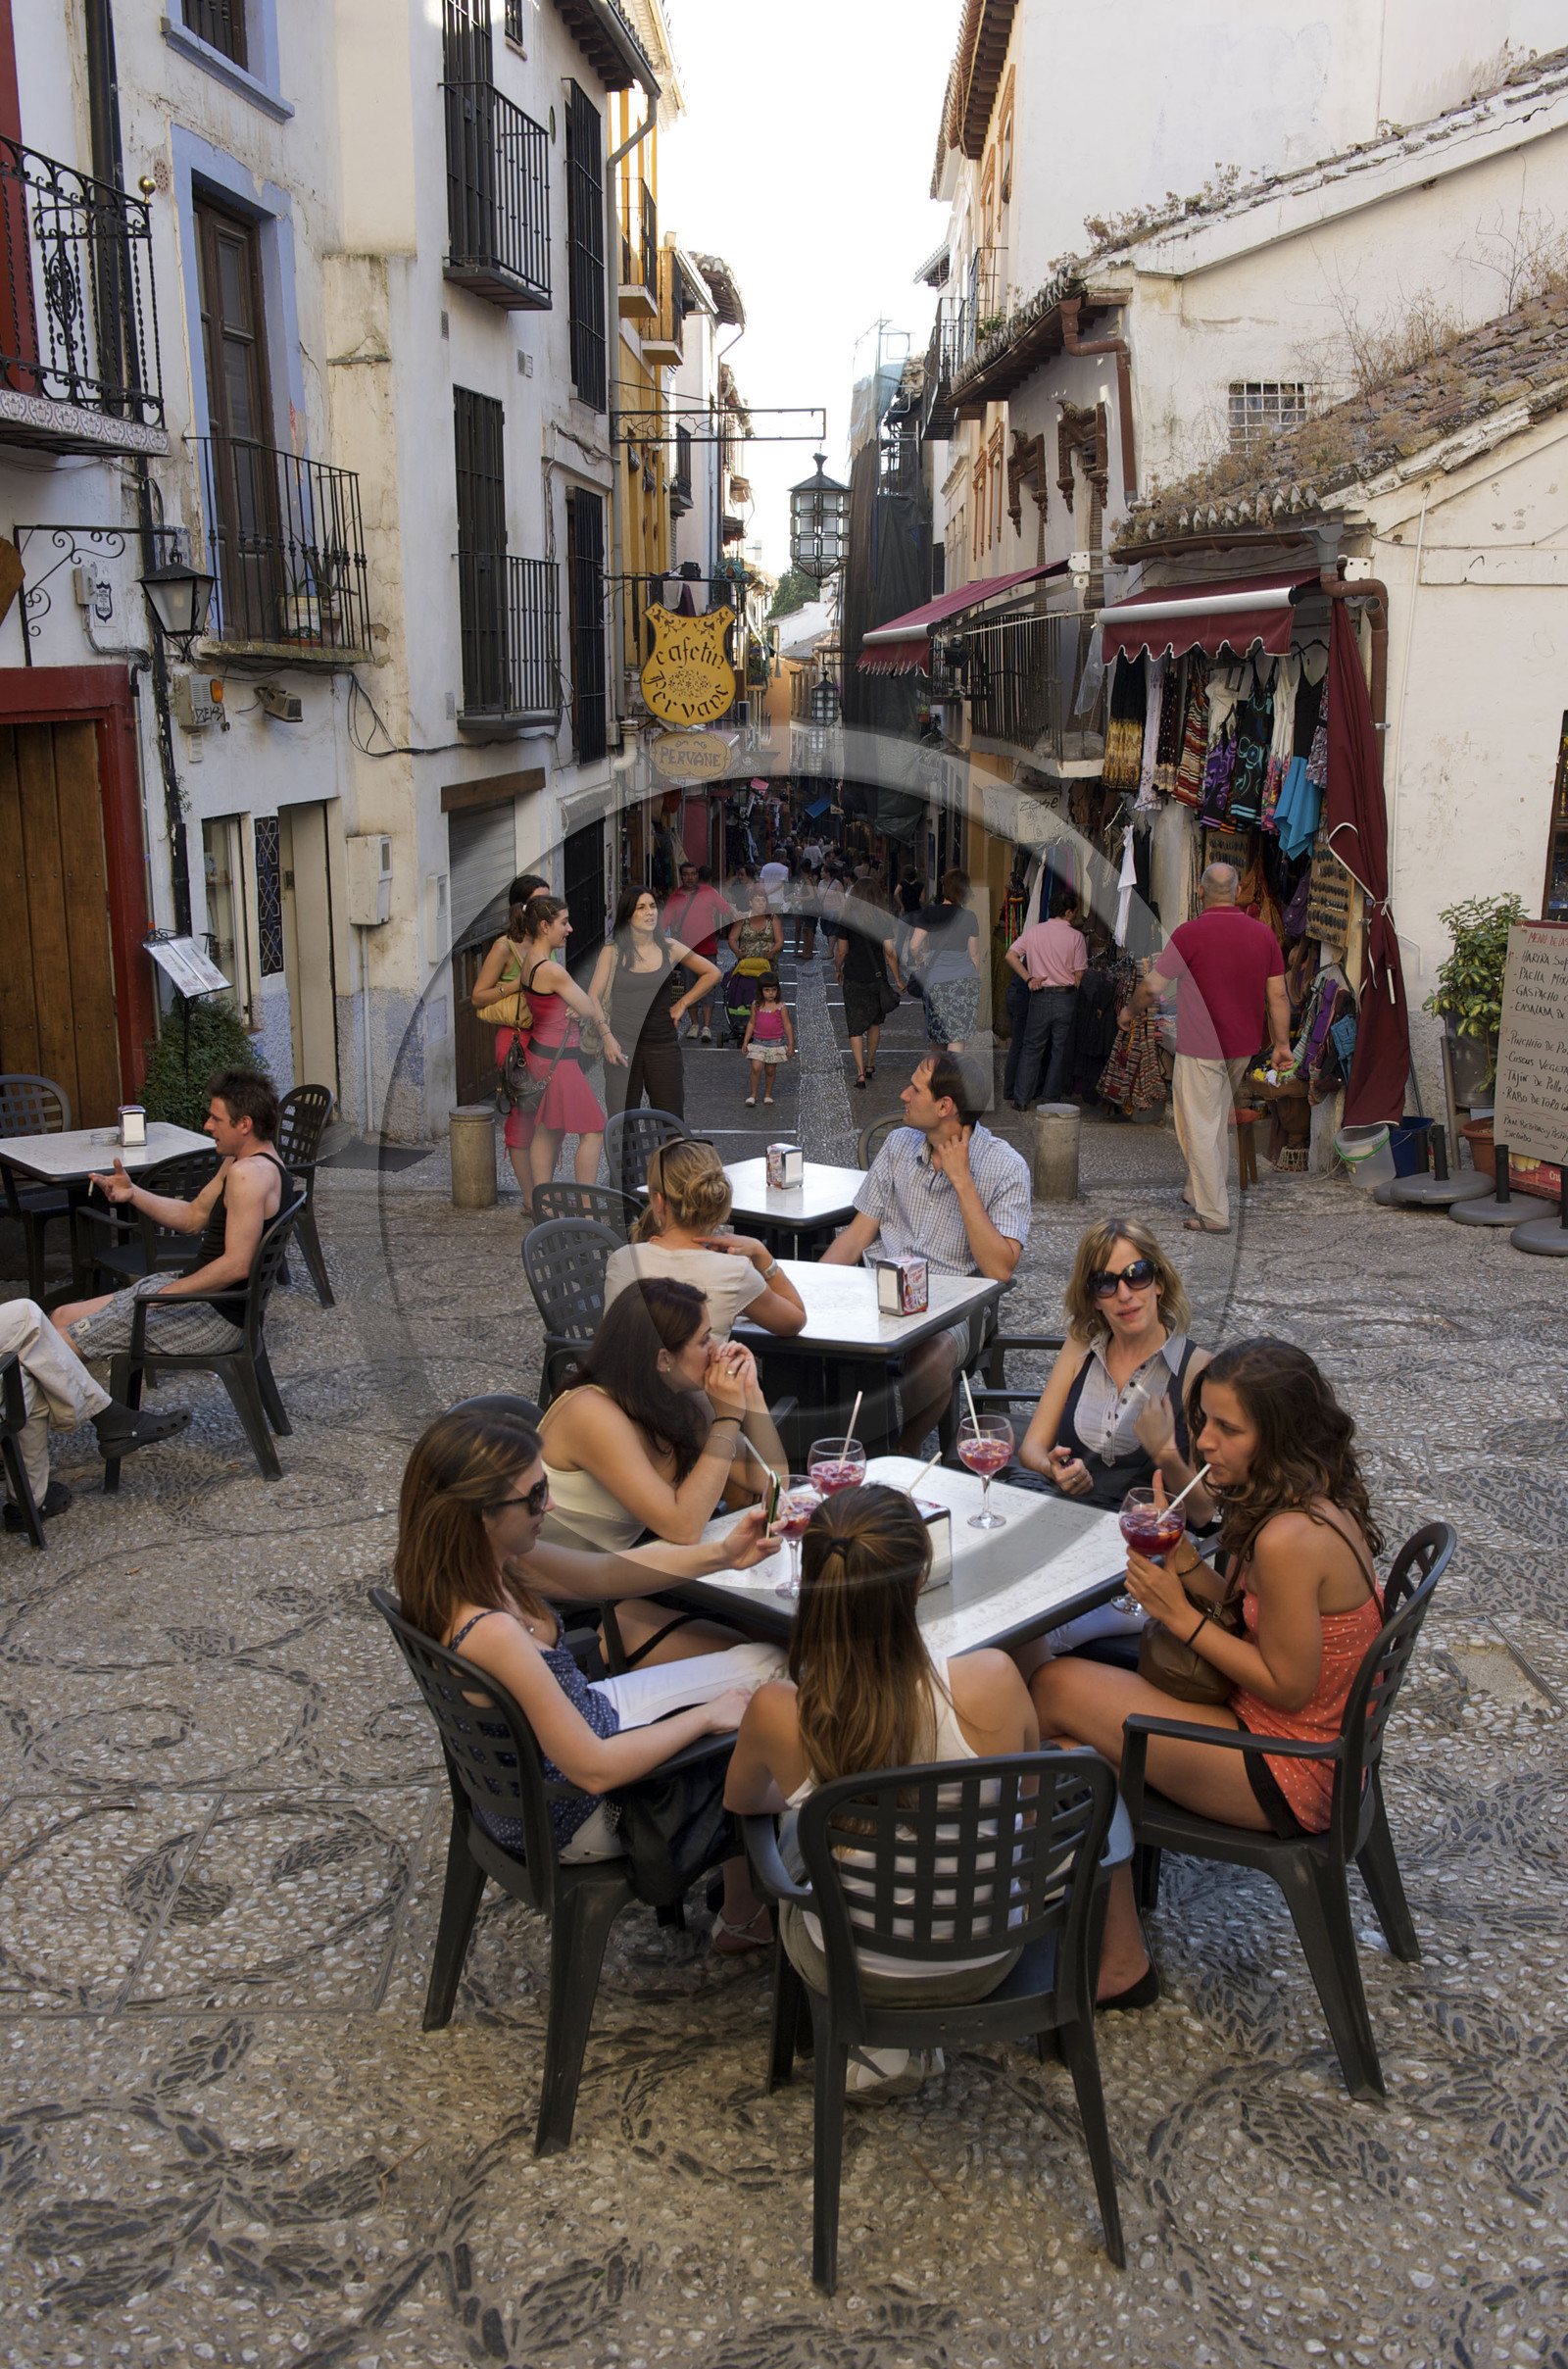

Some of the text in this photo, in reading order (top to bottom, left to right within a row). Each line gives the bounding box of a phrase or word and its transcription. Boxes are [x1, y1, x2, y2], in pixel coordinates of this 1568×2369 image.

[643, 670, 729, 718] Pervane
[660, 745, 722, 767] PERVANE
[1516, 984, 1558, 1002] GASPACHO
[1514, 1002, 1553, 1019] ENSALADA
